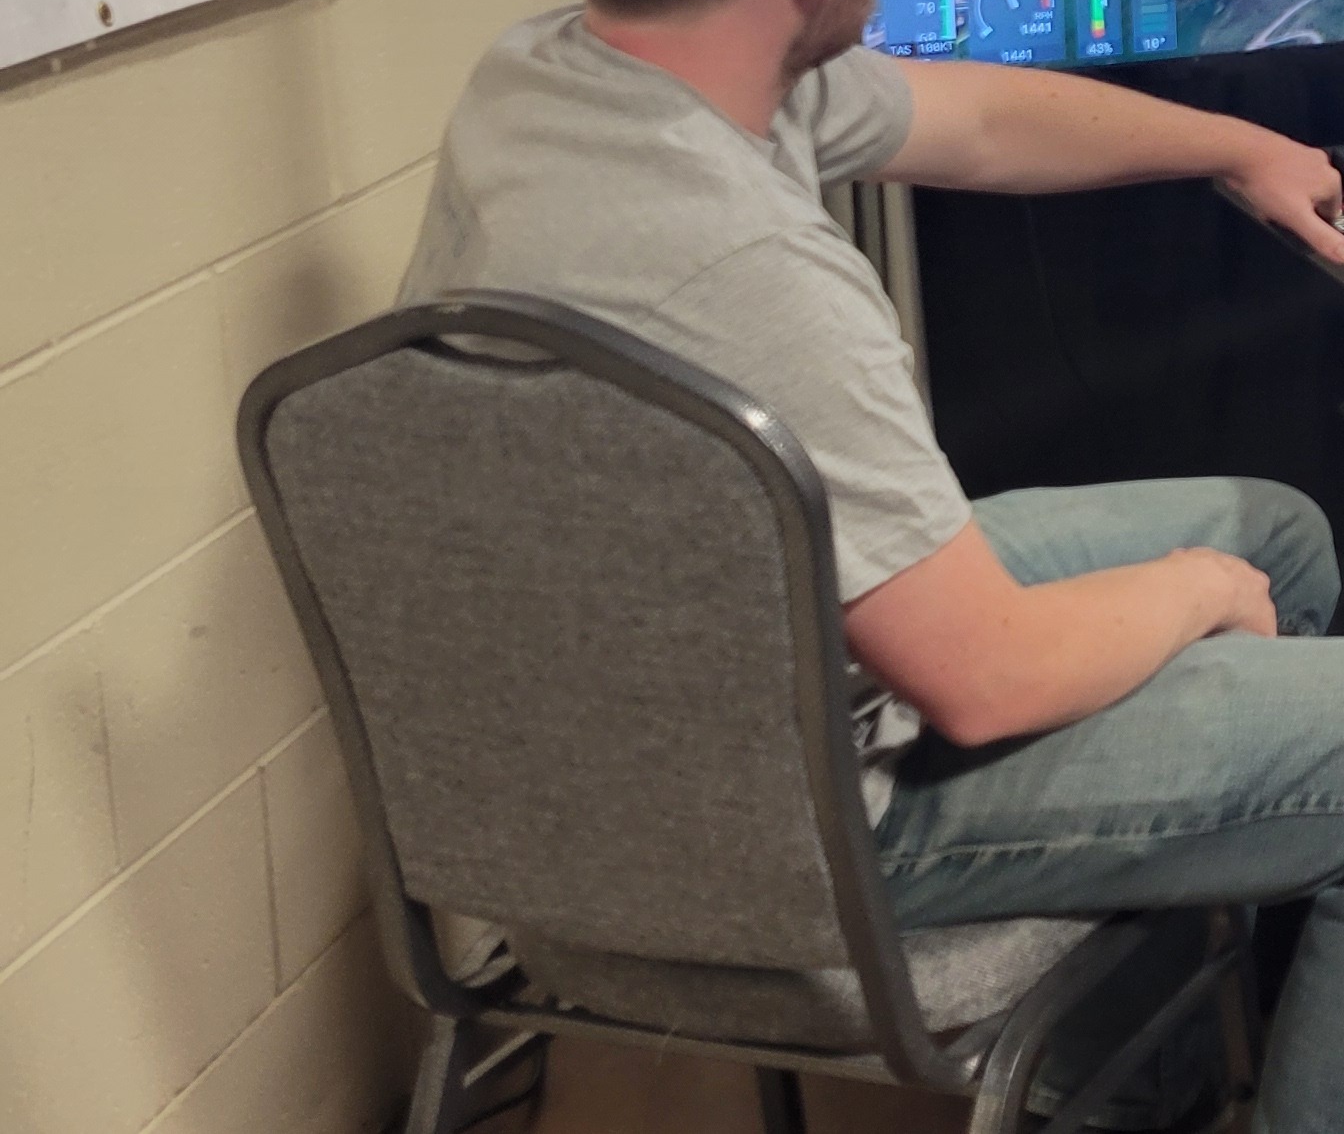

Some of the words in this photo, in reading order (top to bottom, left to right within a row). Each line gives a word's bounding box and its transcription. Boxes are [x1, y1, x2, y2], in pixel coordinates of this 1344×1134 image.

[917, 2, 936, 14] 70
[1021, 22, 1053, 35] 1441
[1085, 42, 1114, 55] 43%
